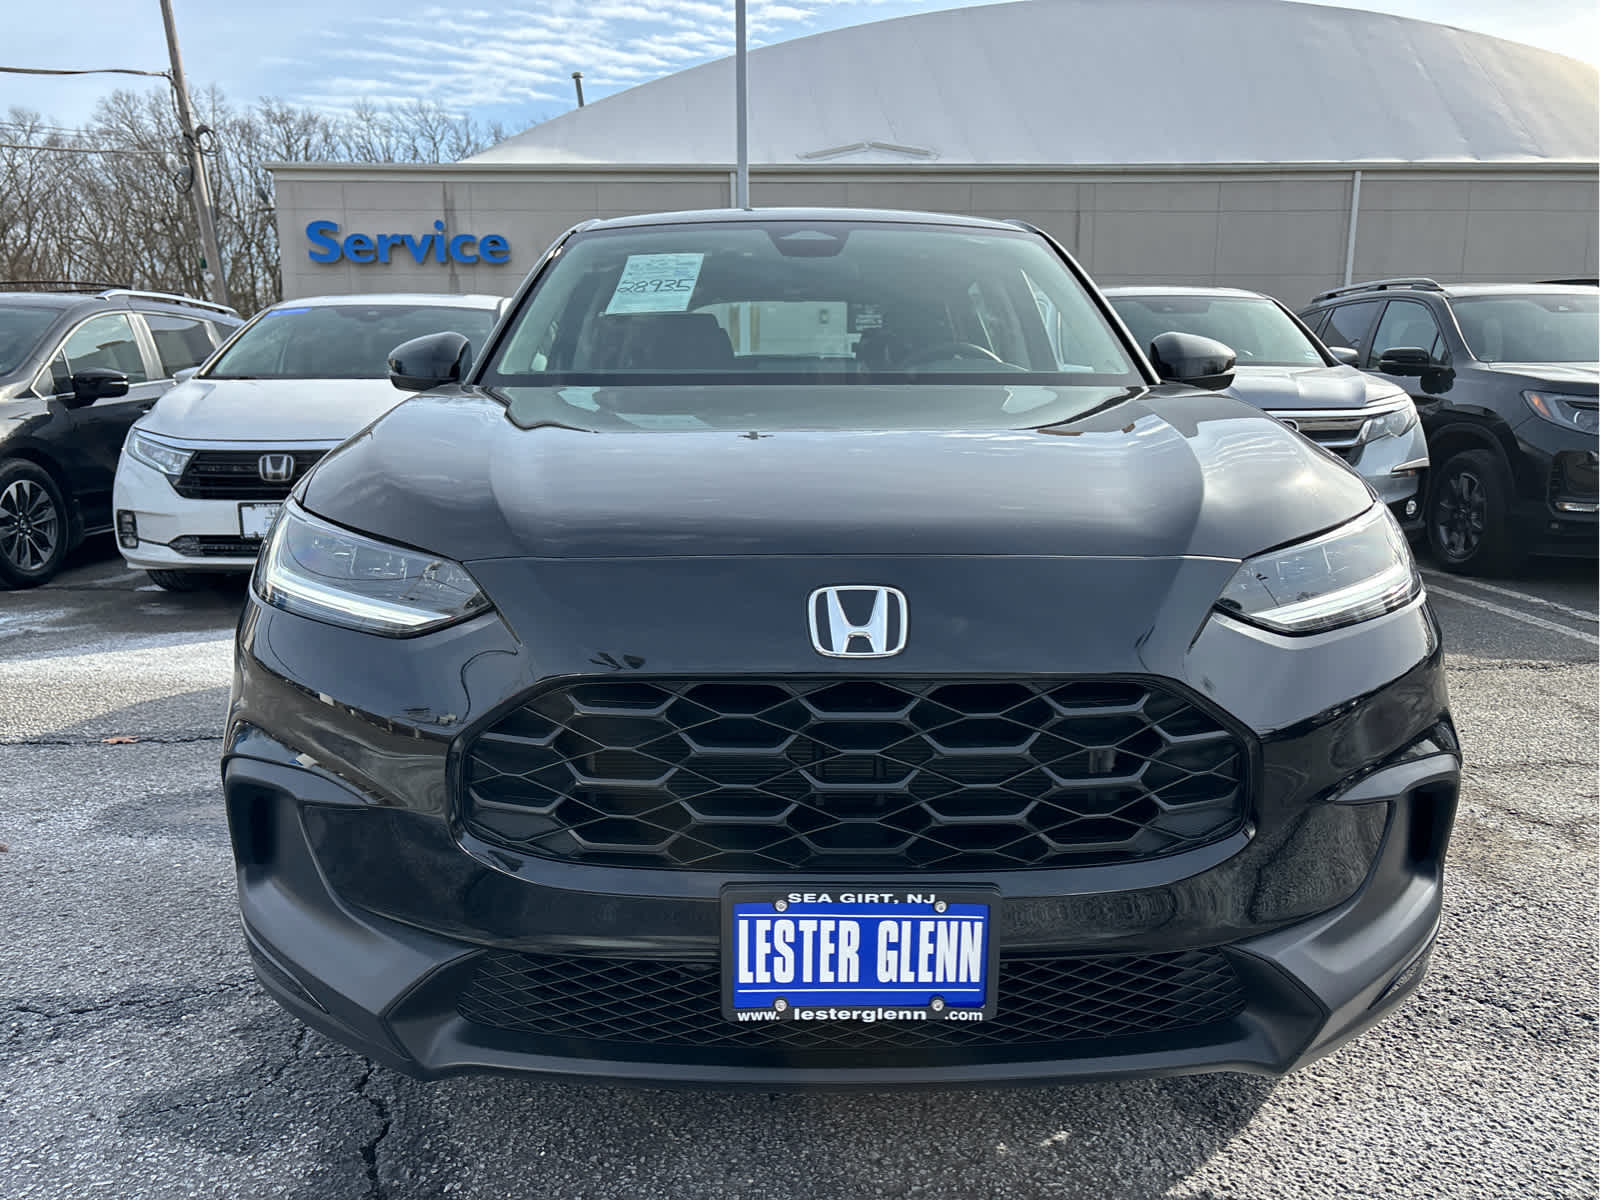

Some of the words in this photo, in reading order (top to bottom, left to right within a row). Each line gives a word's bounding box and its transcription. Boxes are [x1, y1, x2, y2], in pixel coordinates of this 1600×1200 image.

[305, 219, 510, 264] Service
[616, 278, 696, 294] 28935
[787, 893, 832, 904] SEA
[839, 892, 900, 905] GIRT,
[907, 893, 936, 905] NJ
[737, 919, 860, 984] LESTER
[876, 920, 984, 983] GLENN
[736, 1010, 781, 1022] www.
[793, 1007, 927, 1023] lesterglenn
[943, 1009, 983, 1022] .com
